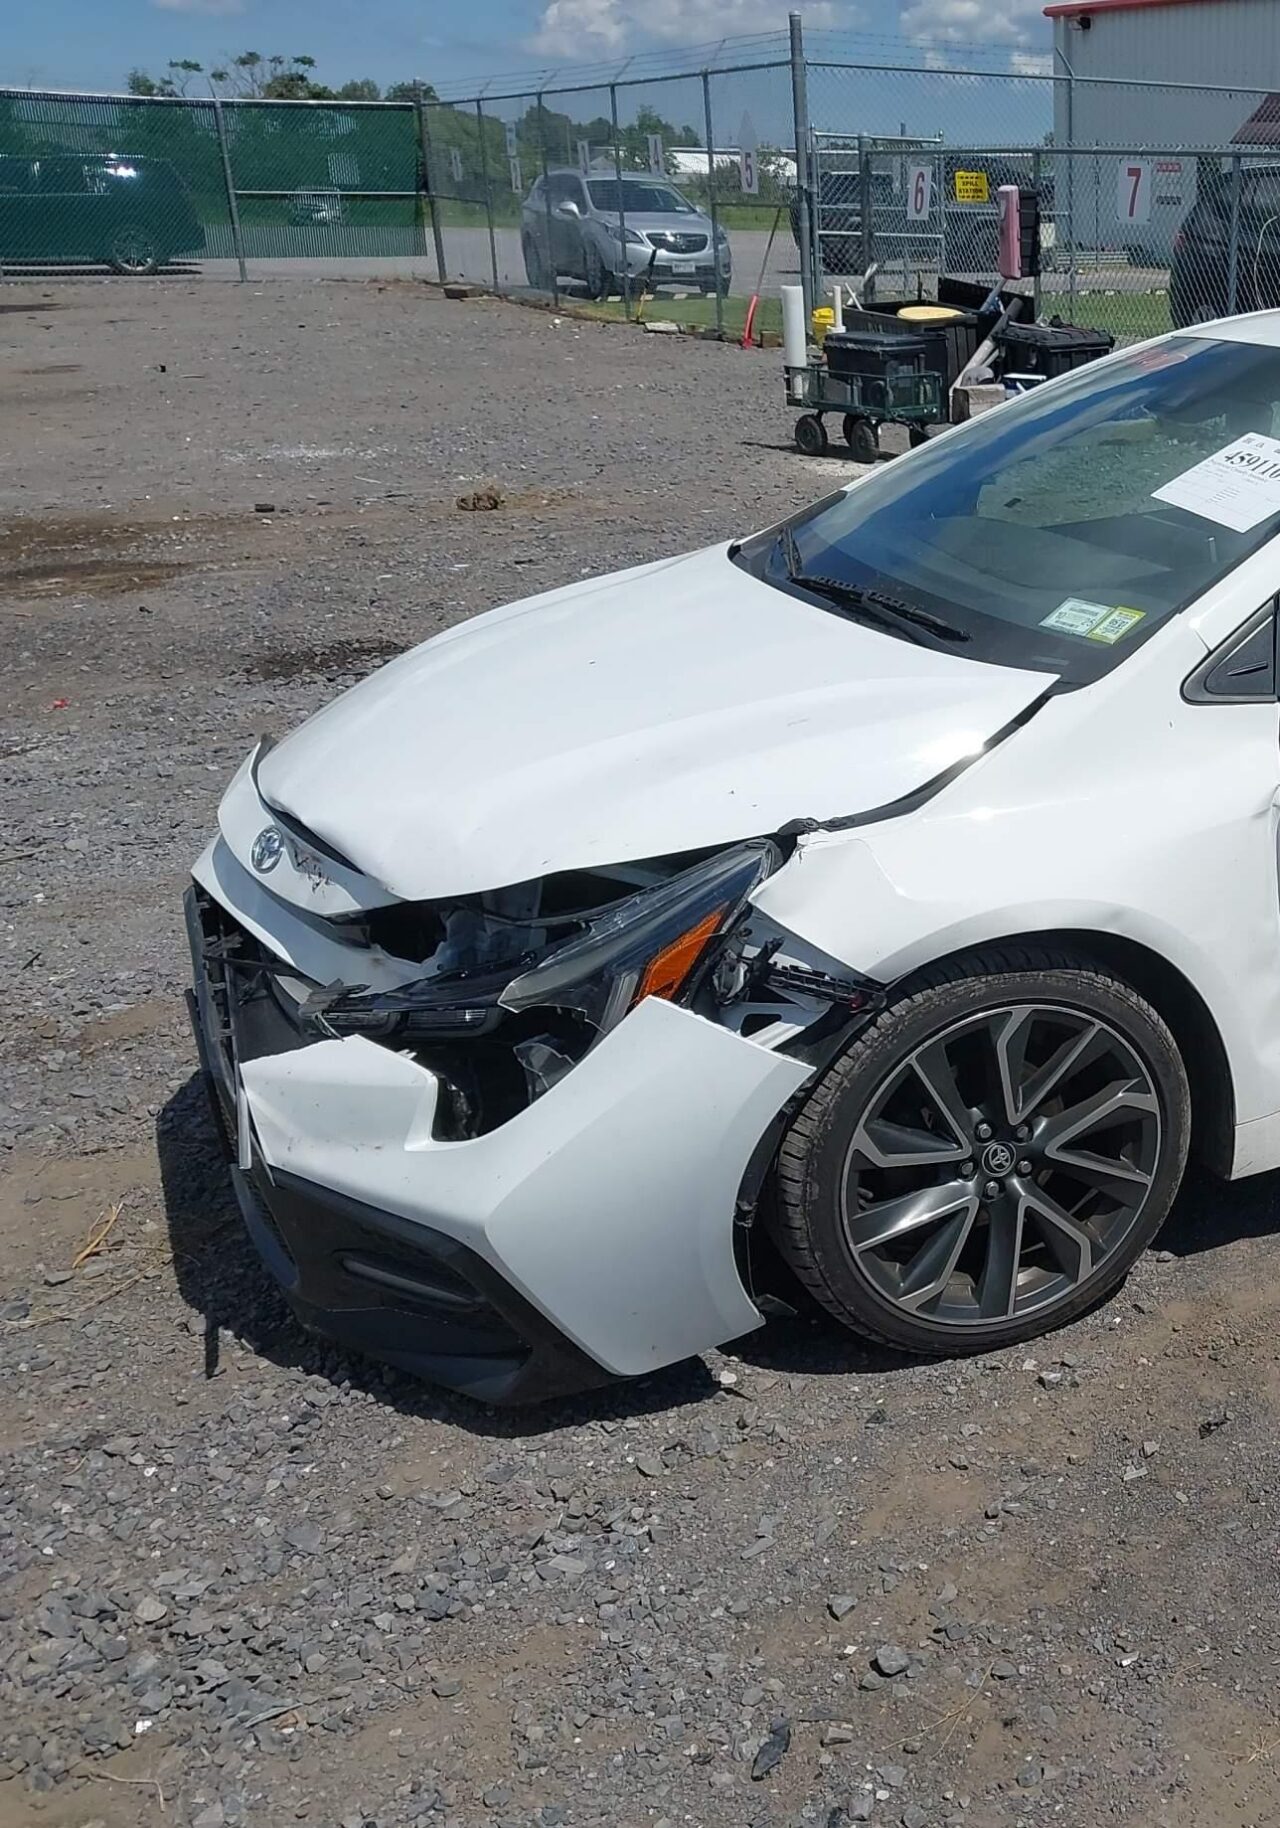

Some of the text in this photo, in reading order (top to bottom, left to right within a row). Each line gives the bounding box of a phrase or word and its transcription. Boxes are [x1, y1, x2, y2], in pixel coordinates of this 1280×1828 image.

[744, 152, 753, 189] 5
[1127, 167, 1142, 218] 7
[914, 171, 925, 215] 6
